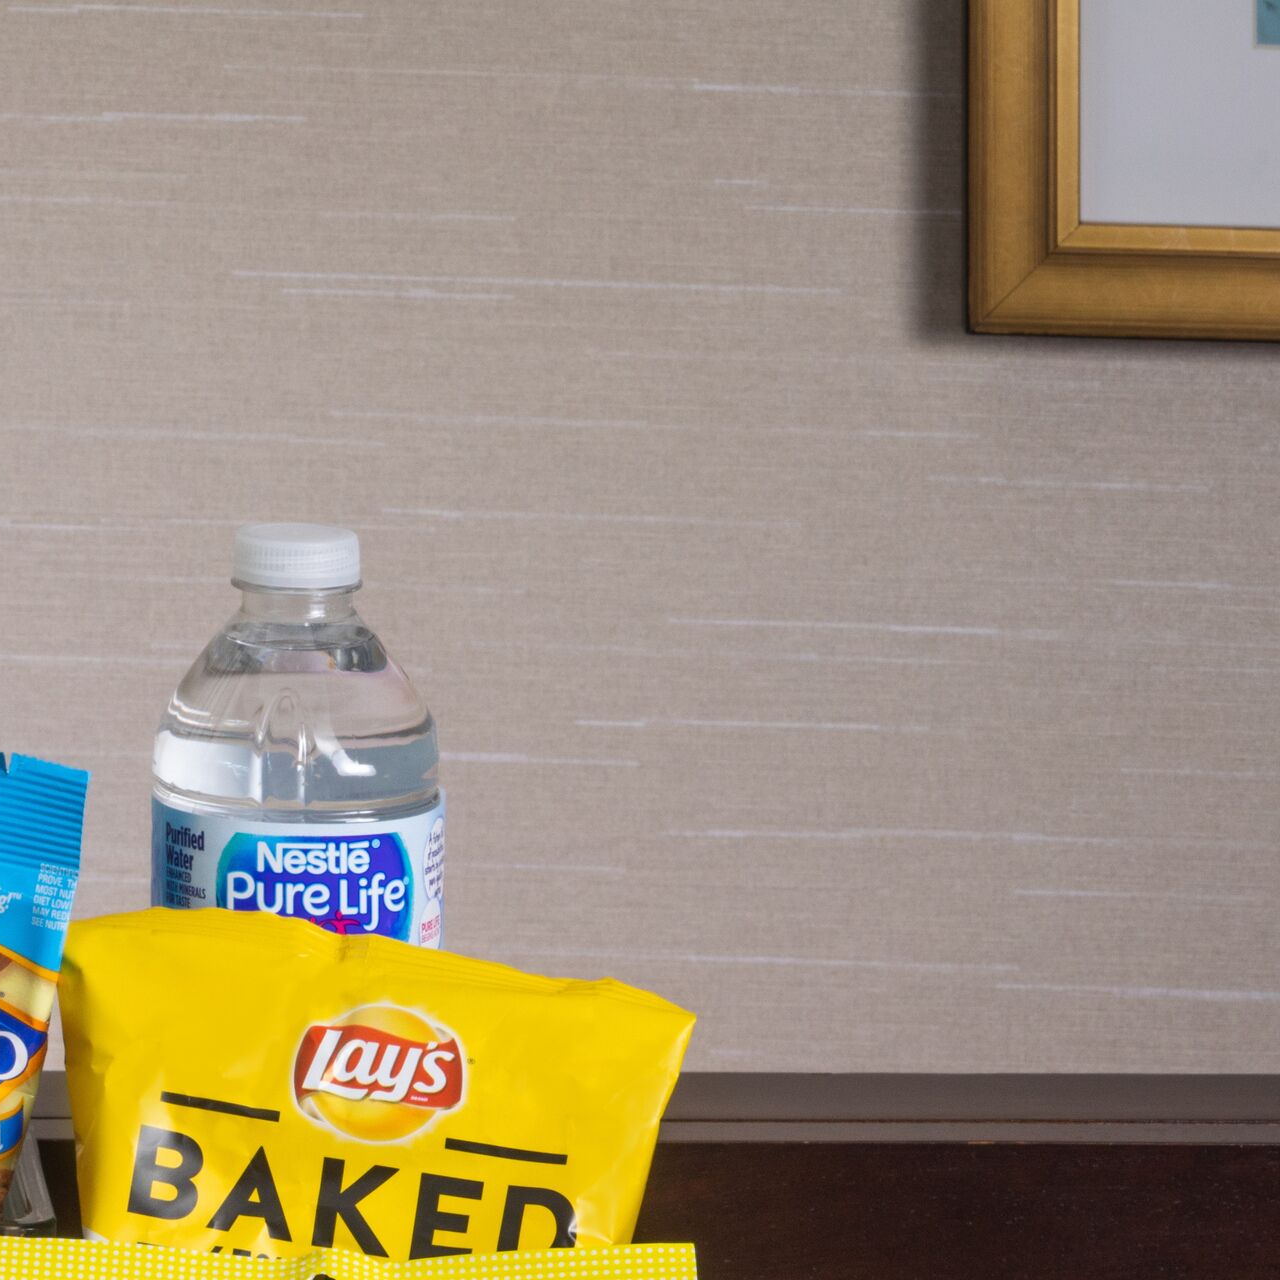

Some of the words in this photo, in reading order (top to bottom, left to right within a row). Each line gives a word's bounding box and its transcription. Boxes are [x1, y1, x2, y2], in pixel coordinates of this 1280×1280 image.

[166, 821, 205, 852] Purified
[166, 843, 194, 871] Water
[257, 840, 371, 876] Nestlé
[226, 871, 330, 915] Pure
[339, 872, 406, 931] Life
[302, 1029, 455, 1104] Lay's
[127, 1124, 577, 1260] BAKED
